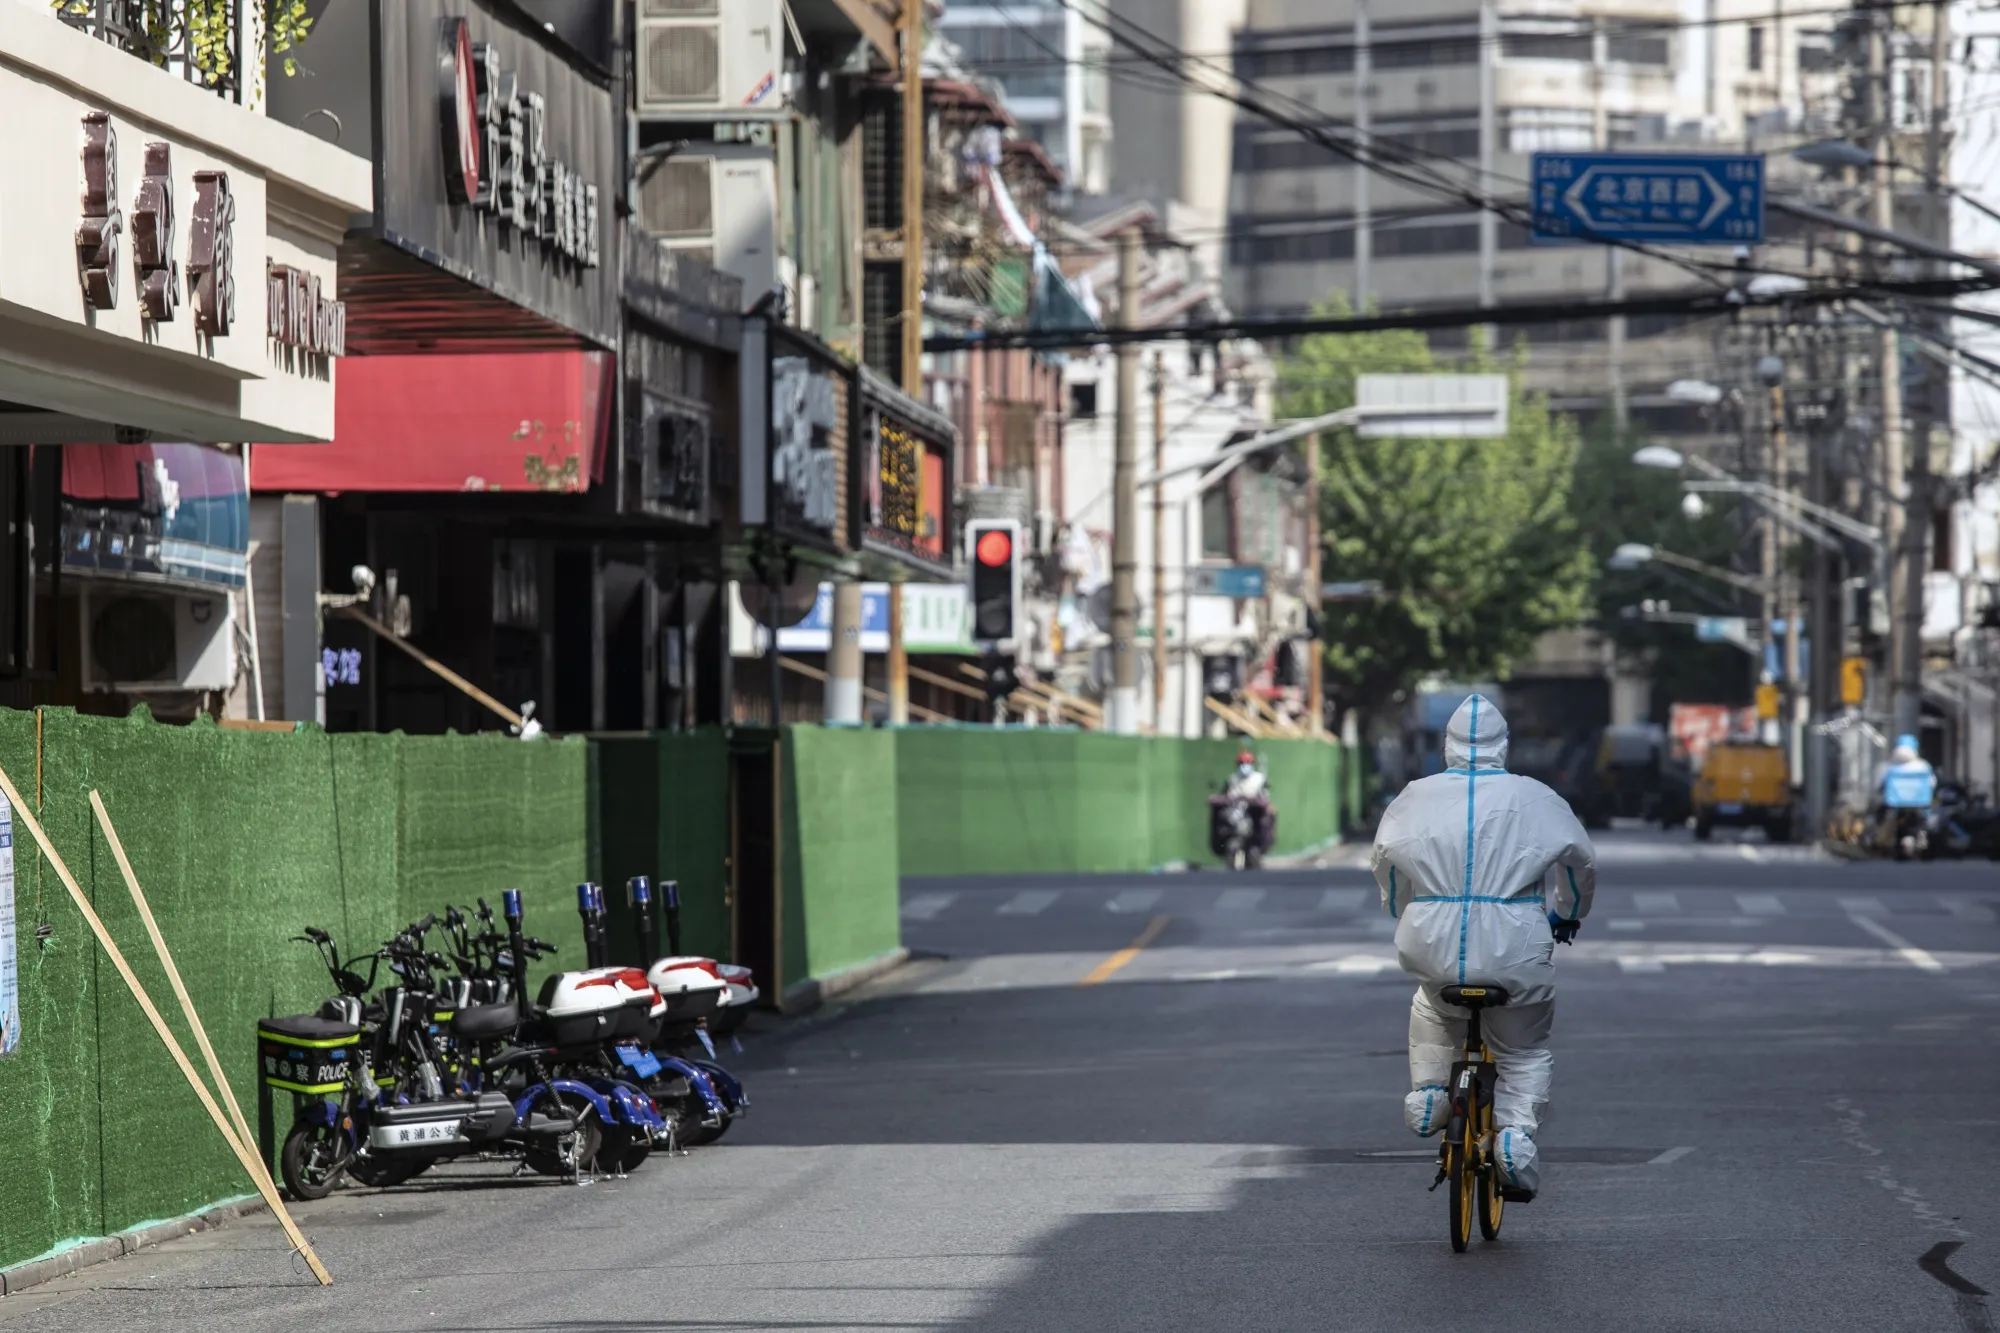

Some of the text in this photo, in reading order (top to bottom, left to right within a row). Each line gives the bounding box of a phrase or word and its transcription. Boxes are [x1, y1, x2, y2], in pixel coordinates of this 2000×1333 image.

[1596, 177, 1700, 204] 北京西路
[266, 256, 285, 339] ue
[317, 1062, 350, 1082] POLICE
[399, 1124, 457, 1141] 黄浦公安
